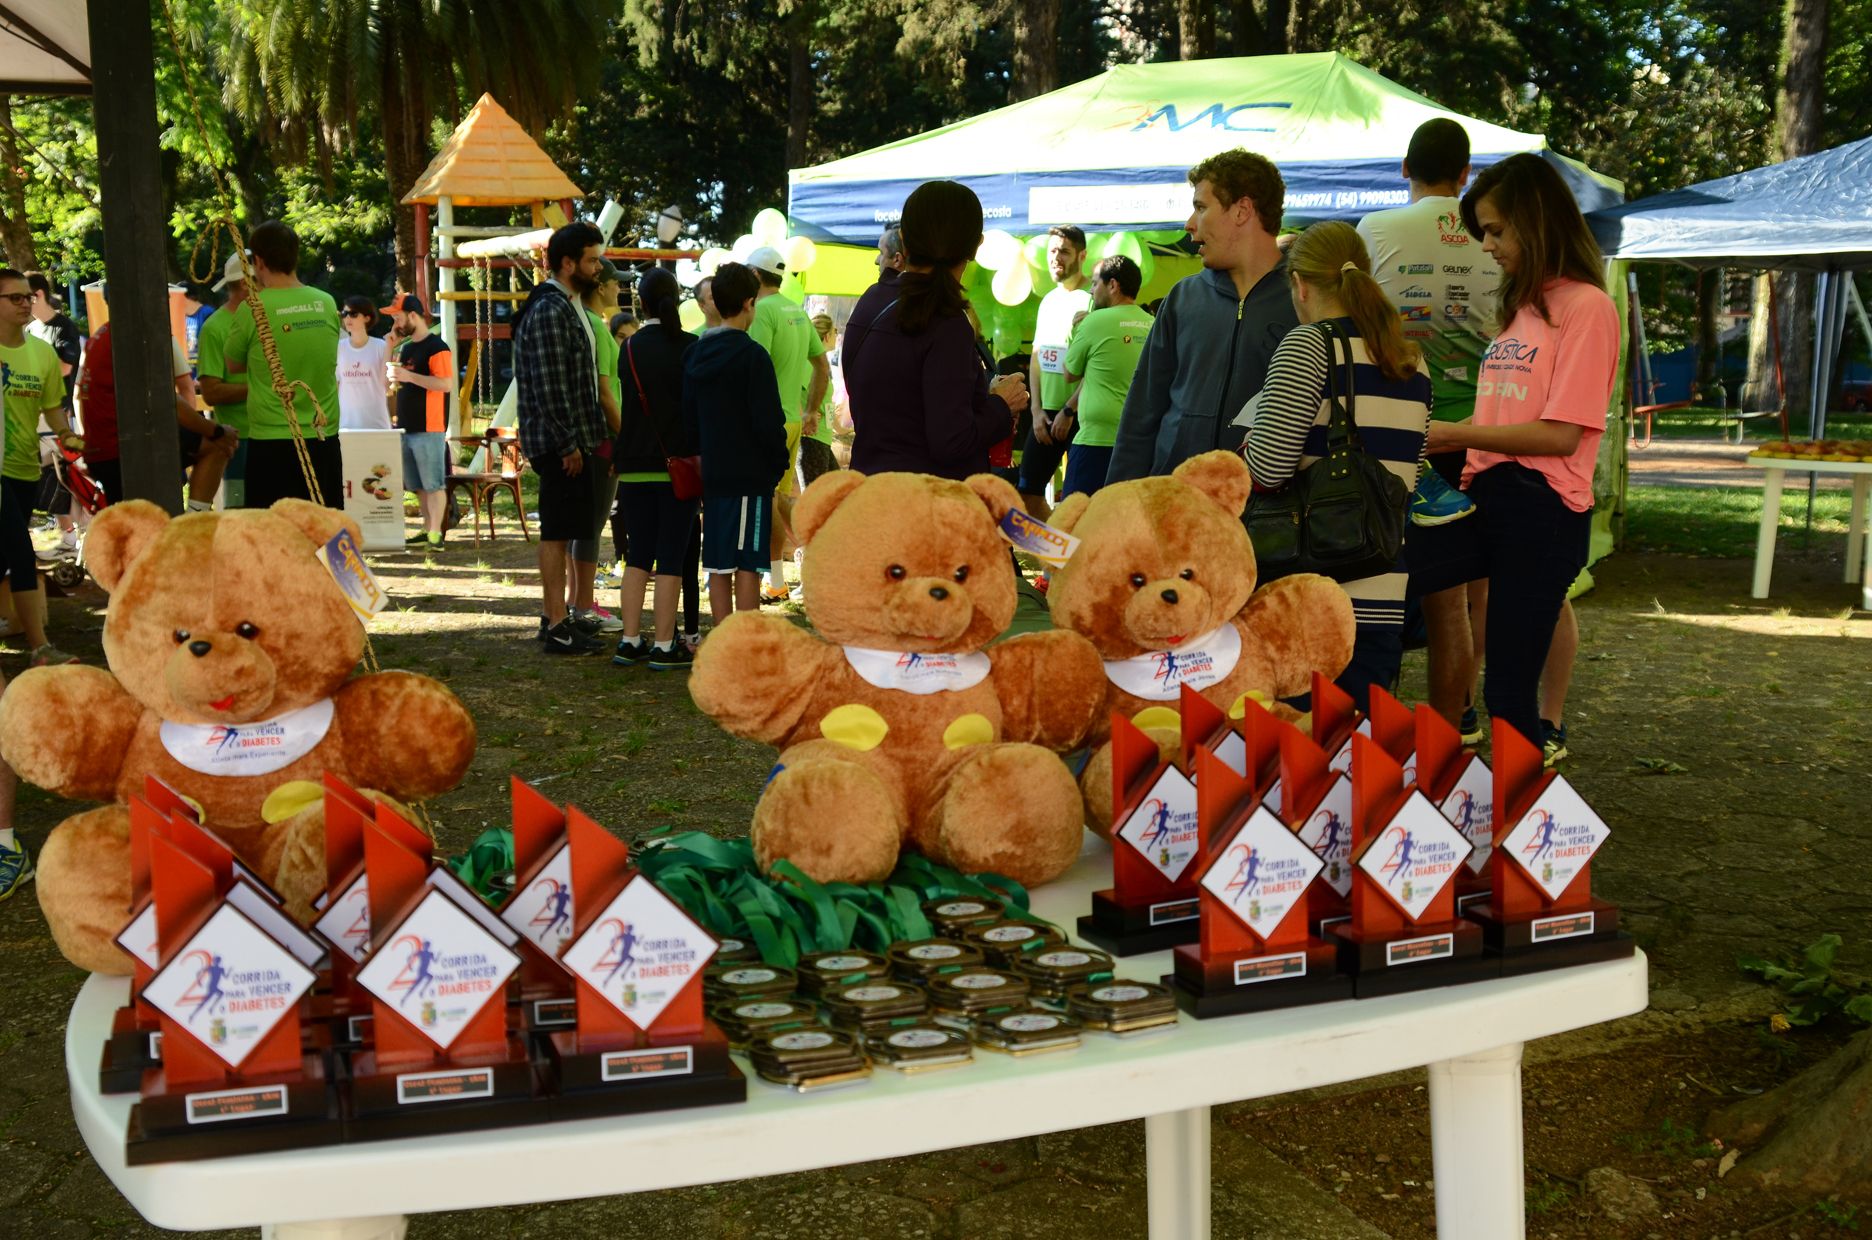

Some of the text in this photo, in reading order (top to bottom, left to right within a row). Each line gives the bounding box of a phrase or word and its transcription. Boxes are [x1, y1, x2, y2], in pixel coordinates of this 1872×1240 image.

[1043, 350, 1058, 362] 45
[1182, 664, 1212, 676] DIABETES
[256, 727, 285, 736] VENCER
[242, 737, 281, 748] DIABETES
[1559, 825, 1589, 837] CORRIDA
[1568, 834, 1595, 845] VENCER
[1418, 842, 1450, 854] CORRIDA
[1555, 846, 1591, 858] DIABETES
[1428, 852, 1456, 863] VENCER
[1265, 858, 1299, 871] CORRIDA
[1414, 863, 1452, 877] DIABETES
[1277, 868, 1307, 880] VENCER
[1263, 881, 1303, 896] DIABETES
[643, 939, 686, 952] CORRIDA
[441, 955, 487, 969] CORRIDA
[658, 950, 696, 963] VENCER
[232, 971, 281, 984] CORRIDA
[457, 966, 497, 980] VENCER
[639, 964, 691, 979] DIABETES
[249, 983, 291, 995] VENCER
[438, 980, 492, 996] DIABETES
[229, 996, 286, 1014] DIABETES
